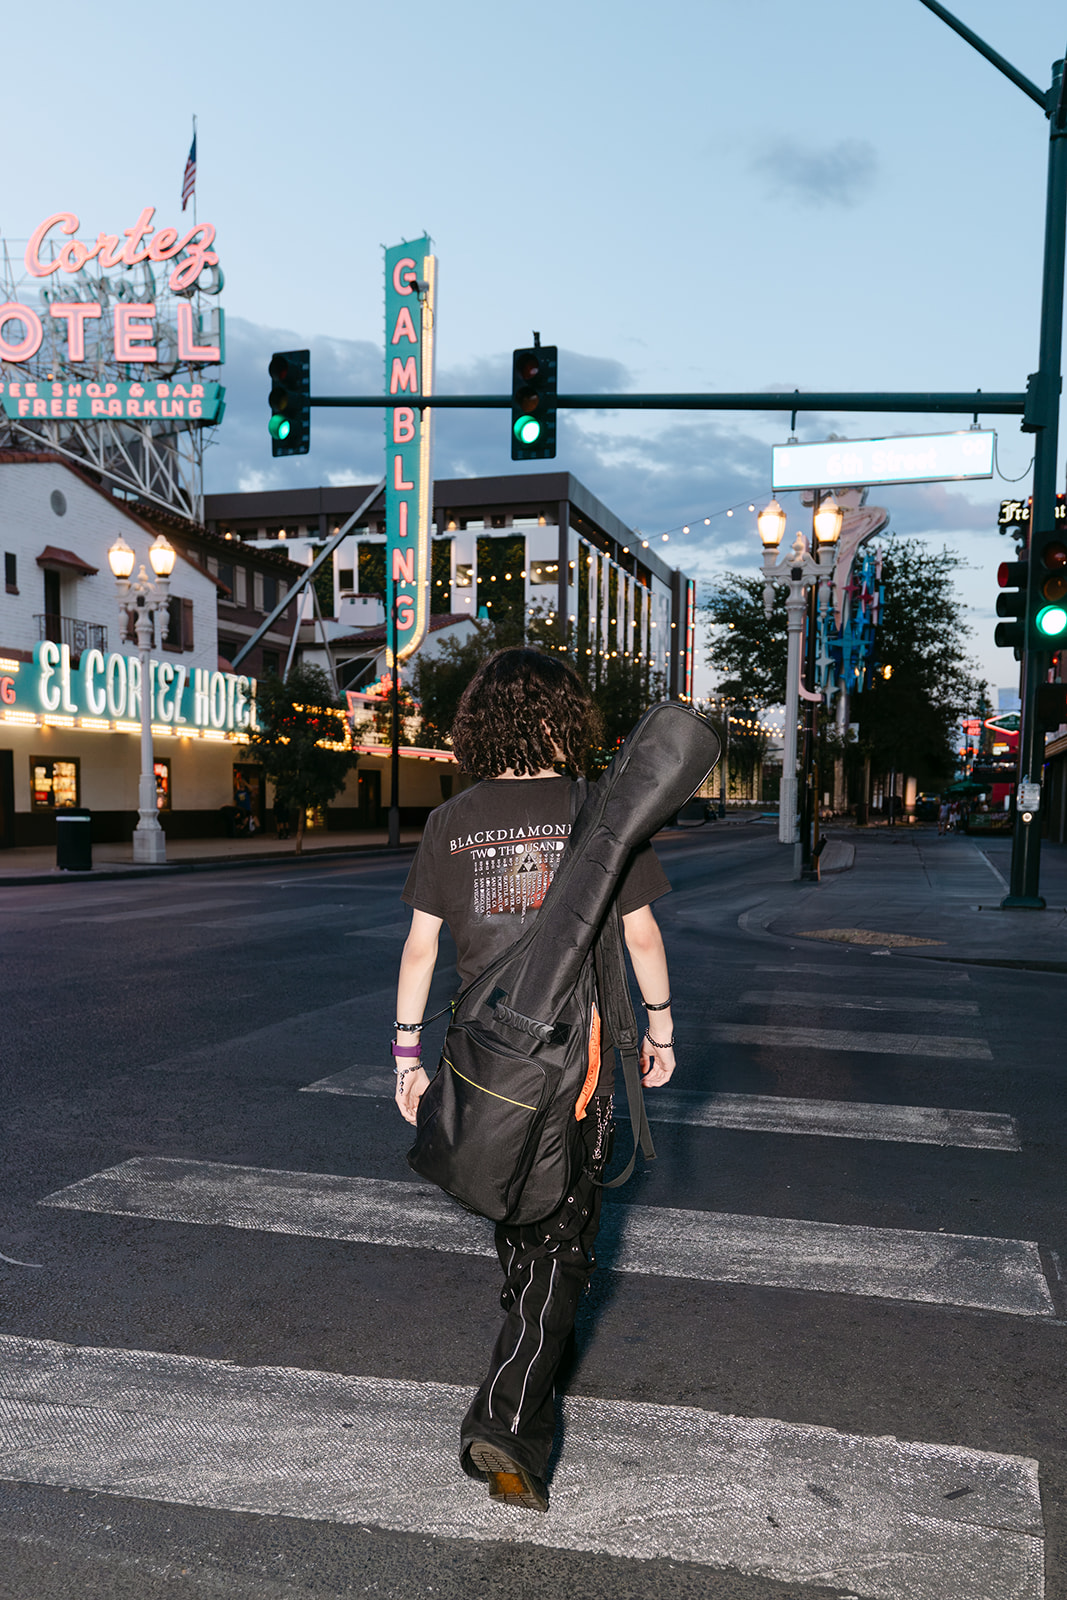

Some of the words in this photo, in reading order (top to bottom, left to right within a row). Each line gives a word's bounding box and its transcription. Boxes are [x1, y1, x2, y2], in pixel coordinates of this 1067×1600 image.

[24, 206, 219, 291] Cortez
[18, 398, 79, 417] FREE
[90, 399, 203, 418] PARKING
[52, 383, 118, 398] SHOP
[129, 383, 145, 397] &
[156, 383, 205, 398] BAR
[389, 257, 418, 631] GAMBLING
[194, 667, 261, 732] HOTEL
[470, 847, 497, 860] TWO
[498, 840, 565, 857] THOUSAND
